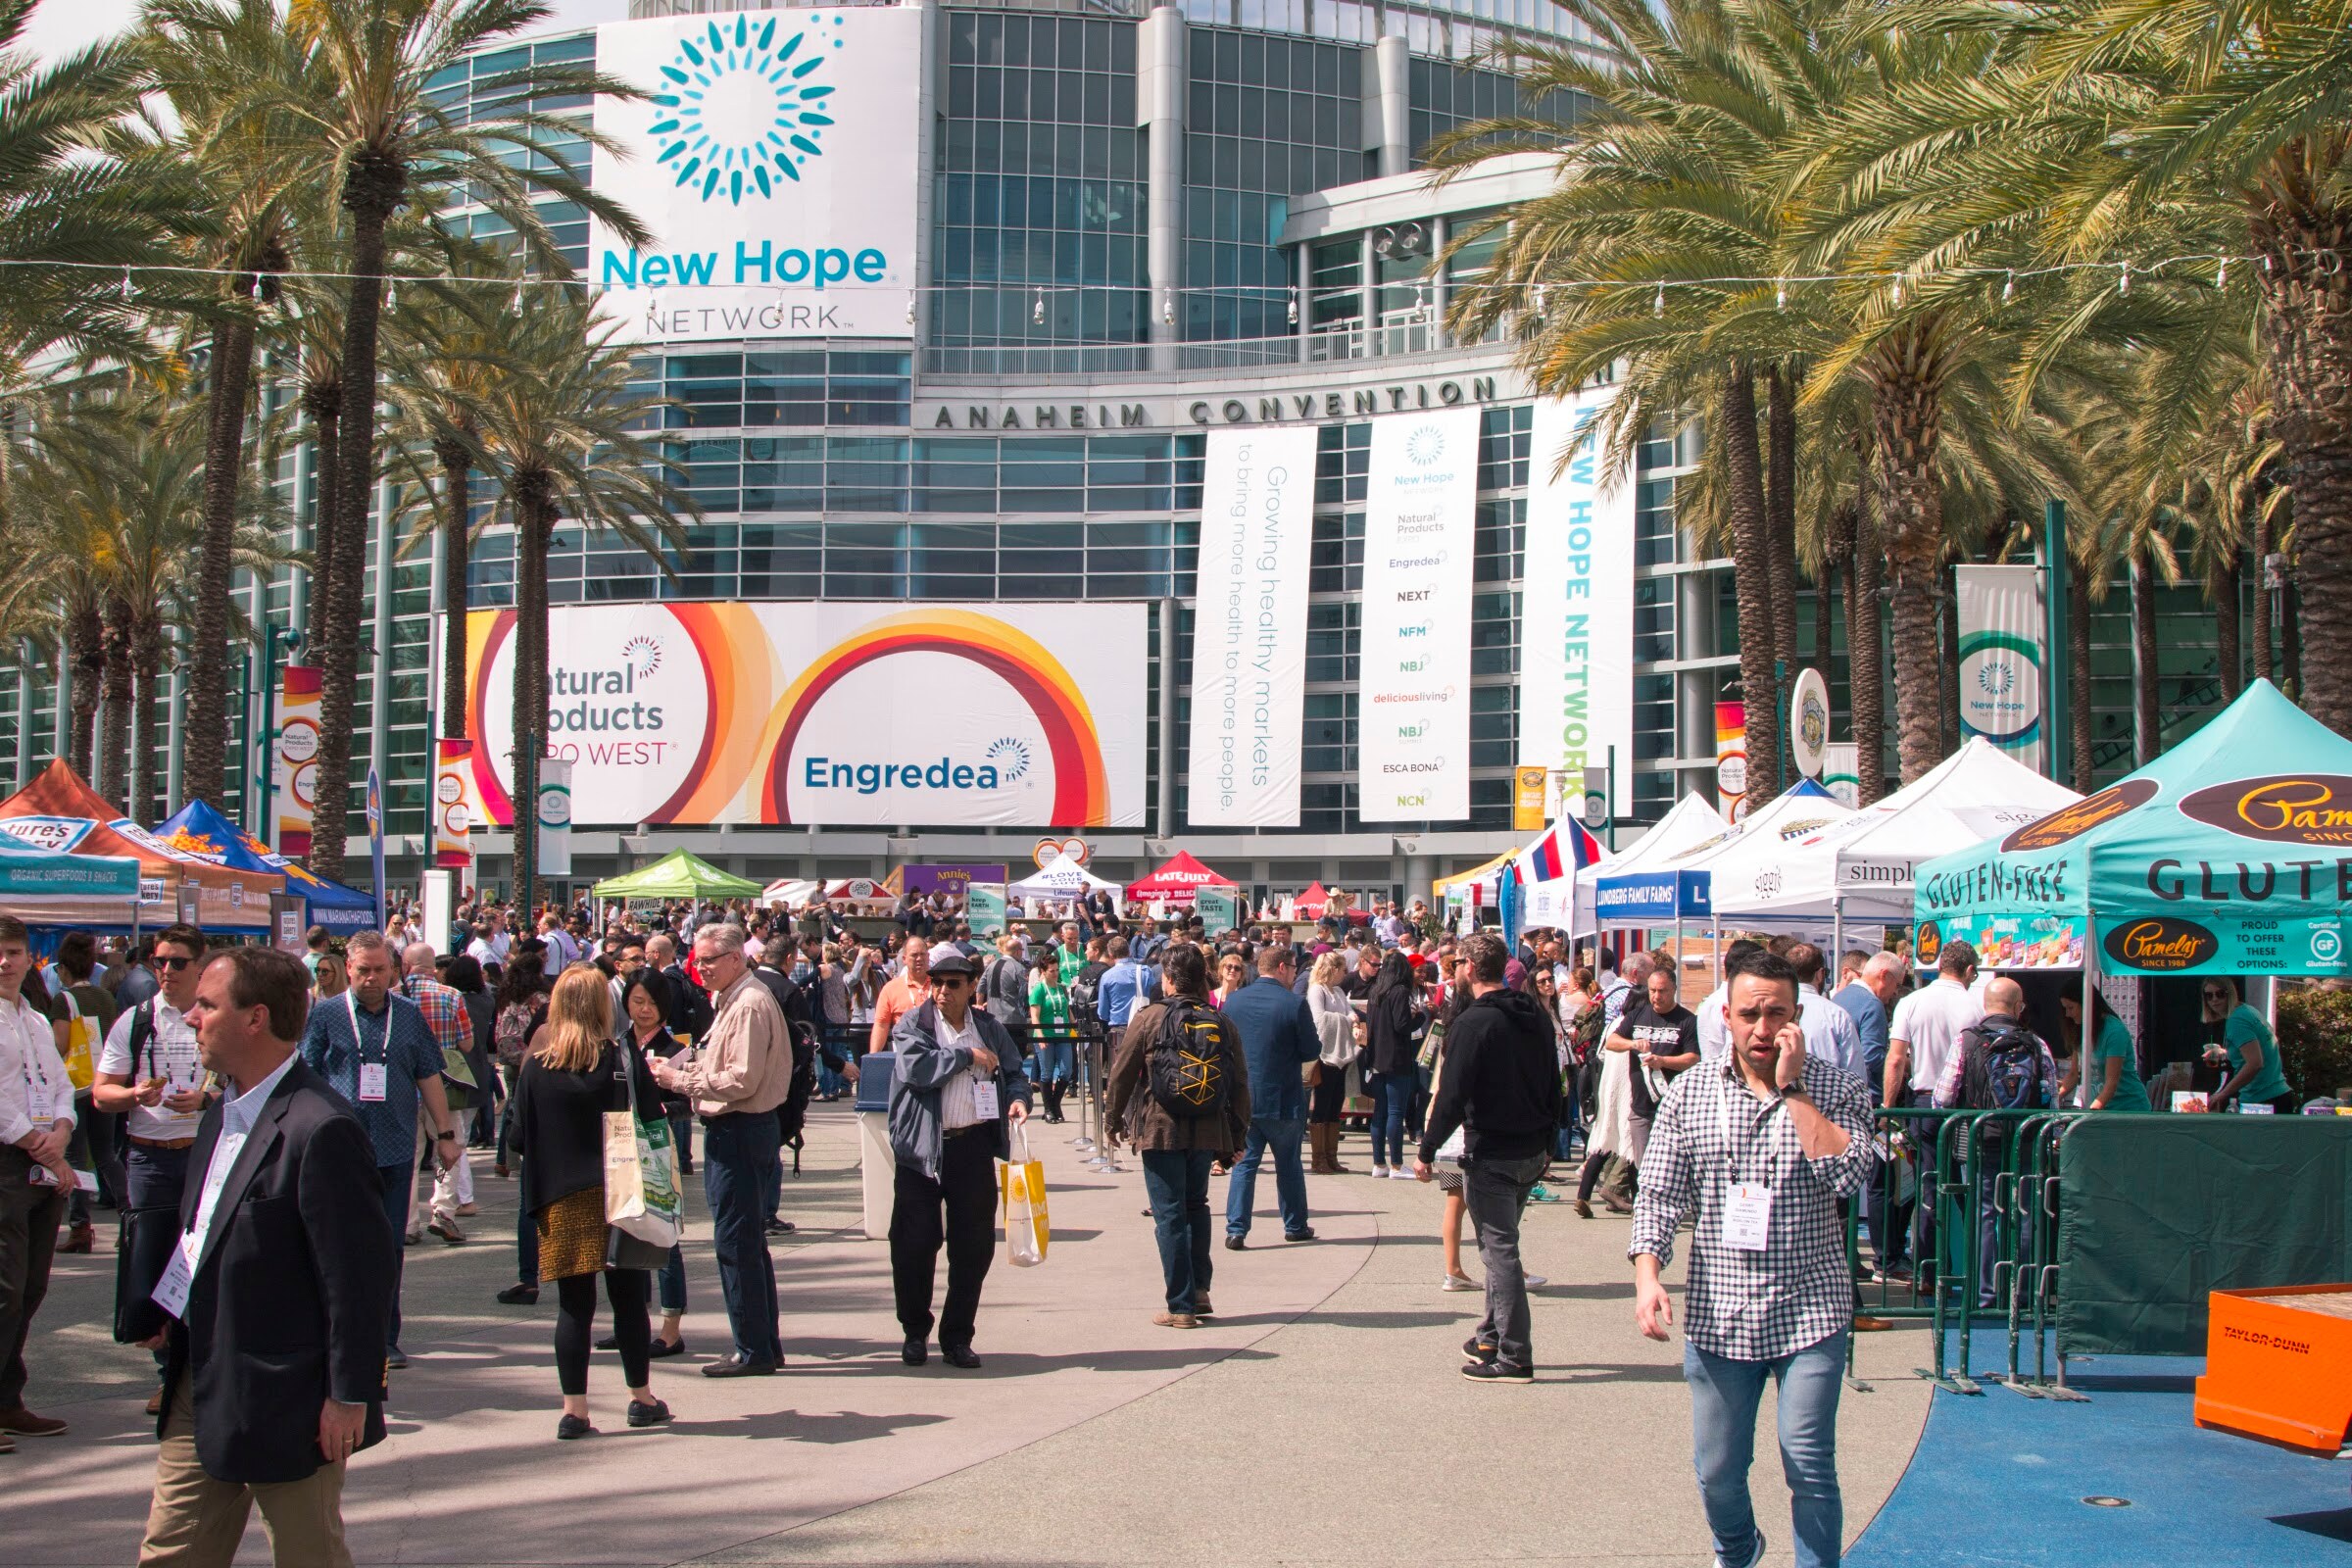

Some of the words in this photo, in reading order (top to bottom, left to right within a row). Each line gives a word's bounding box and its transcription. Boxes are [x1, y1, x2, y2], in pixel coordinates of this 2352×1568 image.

[603, 247, 717, 291] New
[734, 240, 887, 291] Hope
[646, 305, 841, 335] NETWORK
[935, 403, 1144, 428] ANAHEIM
[1189, 376, 1496, 423] CONVENTION
[1238, 444, 1252, 462] to
[1394, 475, 1420, 486] New
[1423, 471, 1455, 484] Hope
[1230, 467, 1252, 517] bring
[1256, 466, 1288, 571] Growing
[1397, 512, 1437, 524] Natural
[1396, 522, 1445, 534] Products
[1231, 523, 1246, 575] more
[1567, 500, 1592, 601] HOPE
[1389, 556, 1441, 569] Engredea
[1396, 590, 1430, 602] NEXT
[1227, 581, 1246, 644] health
[1251, 579, 1281, 672] healthy
[1398, 626, 1427, 637] NFM
[1226, 651, 1240, 669] to
[1399, 661, 1424, 672] NBJ
[548, 662, 634, 696] tural
[1223, 676, 1237, 730] more
[1373, 692, 1447, 704] deliciousliving
[1970, 701, 1994, 710] New
[1996, 701, 2026, 710] Hope
[1562, 613, 1590, 802] NETWORK
[548, 701, 664, 733] oducts
[1252, 681, 1274, 786] markets
[1398, 726, 1423, 738] NBJ
[588, 742, 667, 765] WEST
[806, 757, 999, 795] Engredea
[1217, 736, 1238, 811] people.
[1383, 764, 1408, 773] ESCA
[1410, 762, 1439, 772] BONA
[1396, 795, 1425, 807] NCN
[8, 822, 70, 837] ture's
[11, 868, 42, 881] ORGANIC
[44, 868, 87, 881] SUPERFOODS
[93, 870, 118, 883] SNACKS
[937, 869, 972, 881] Annie's
[1154, 871, 1183, 882] LATE
[1180, 872, 1212, 882] JULY
[1927, 859, 2068, 909] GLUTEN-FREE
[2147, 858, 2352, 902] GLUTE
[141, 891, 159, 901] kery
[629, 899, 662, 911] RAWHIDE
[1597, 888, 1627, 906] LUNDBERG
[1628, 887, 1650, 904] FAMILY
[1649, 886, 1672, 903] FARMS
[2241, 920, 2278, 930] PROUD
[2124, 922, 2199, 958] Pamela's
[2236, 934, 2250, 943] TO
[2253, 934, 2284, 943] OFFER
[2316, 940, 2334, 951] GF
[2246, 947, 2277, 956] THESE
[2237, 959, 2287, 969] OPTIONS:
[2224, 1326, 2311, 1354] TAYLOR-DUNN
